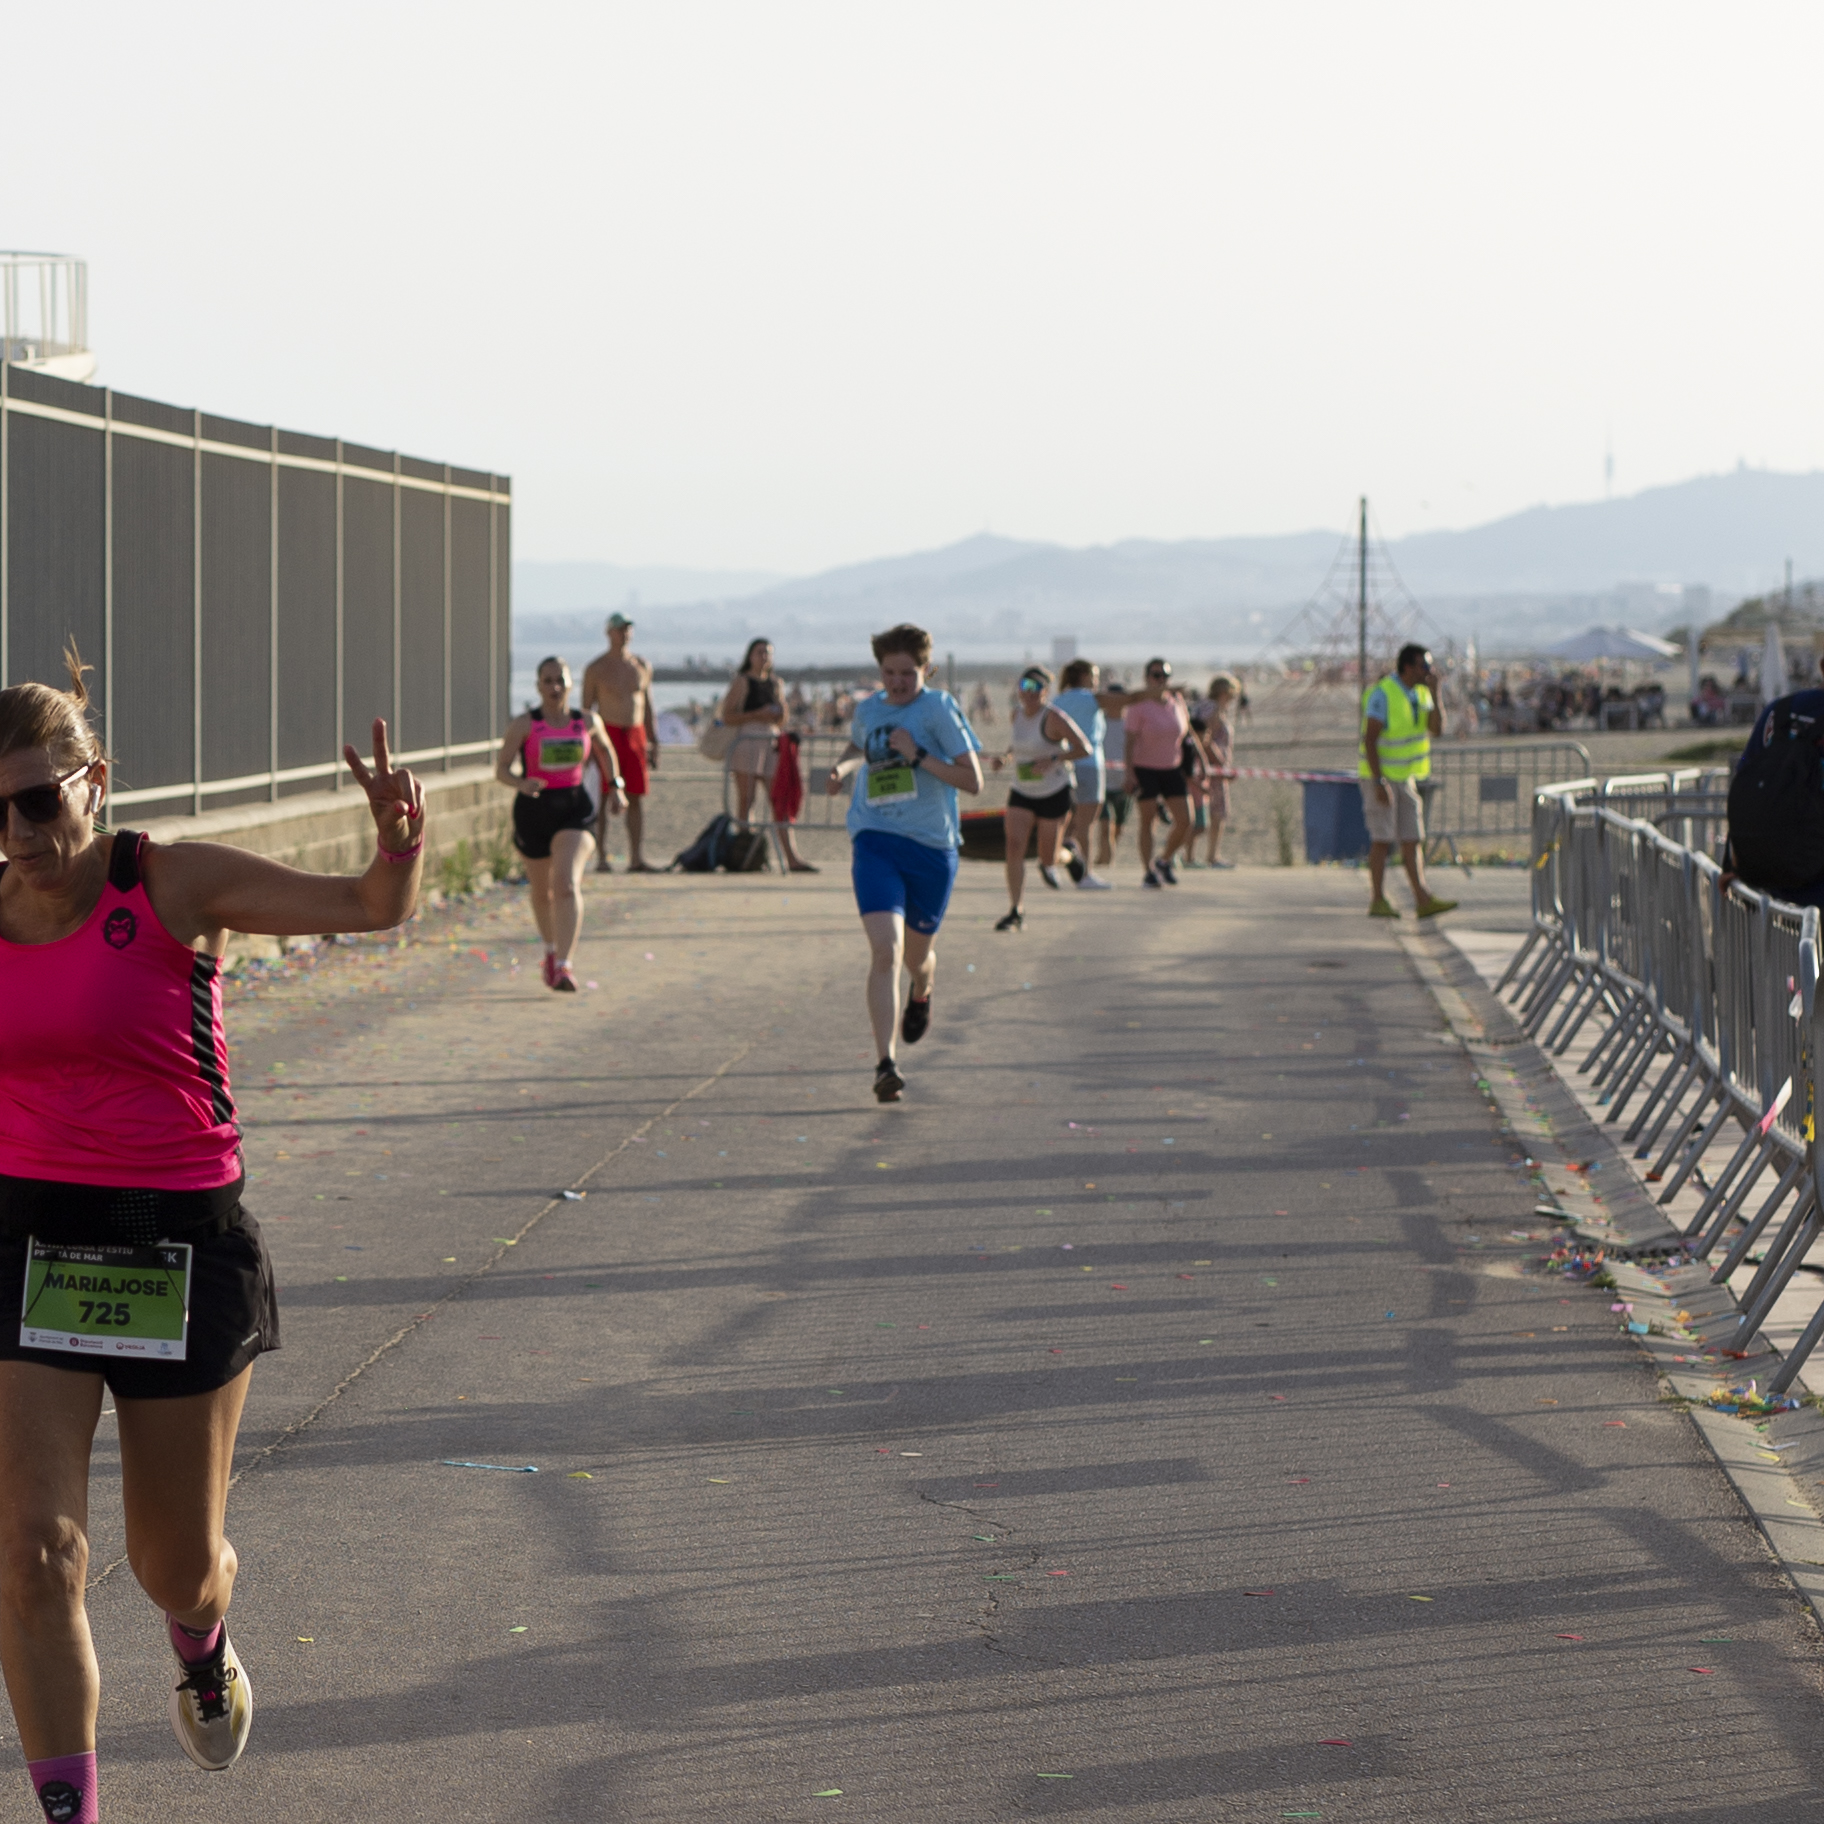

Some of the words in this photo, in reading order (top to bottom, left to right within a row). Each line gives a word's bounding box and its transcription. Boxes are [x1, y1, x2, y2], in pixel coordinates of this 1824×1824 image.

[69, 1252, 82, 1261] DE
[83, 1252, 104, 1262] MAR
[45, 1272, 169, 1297] MARIAJOSE
[78, 1300, 131, 1326] 725
